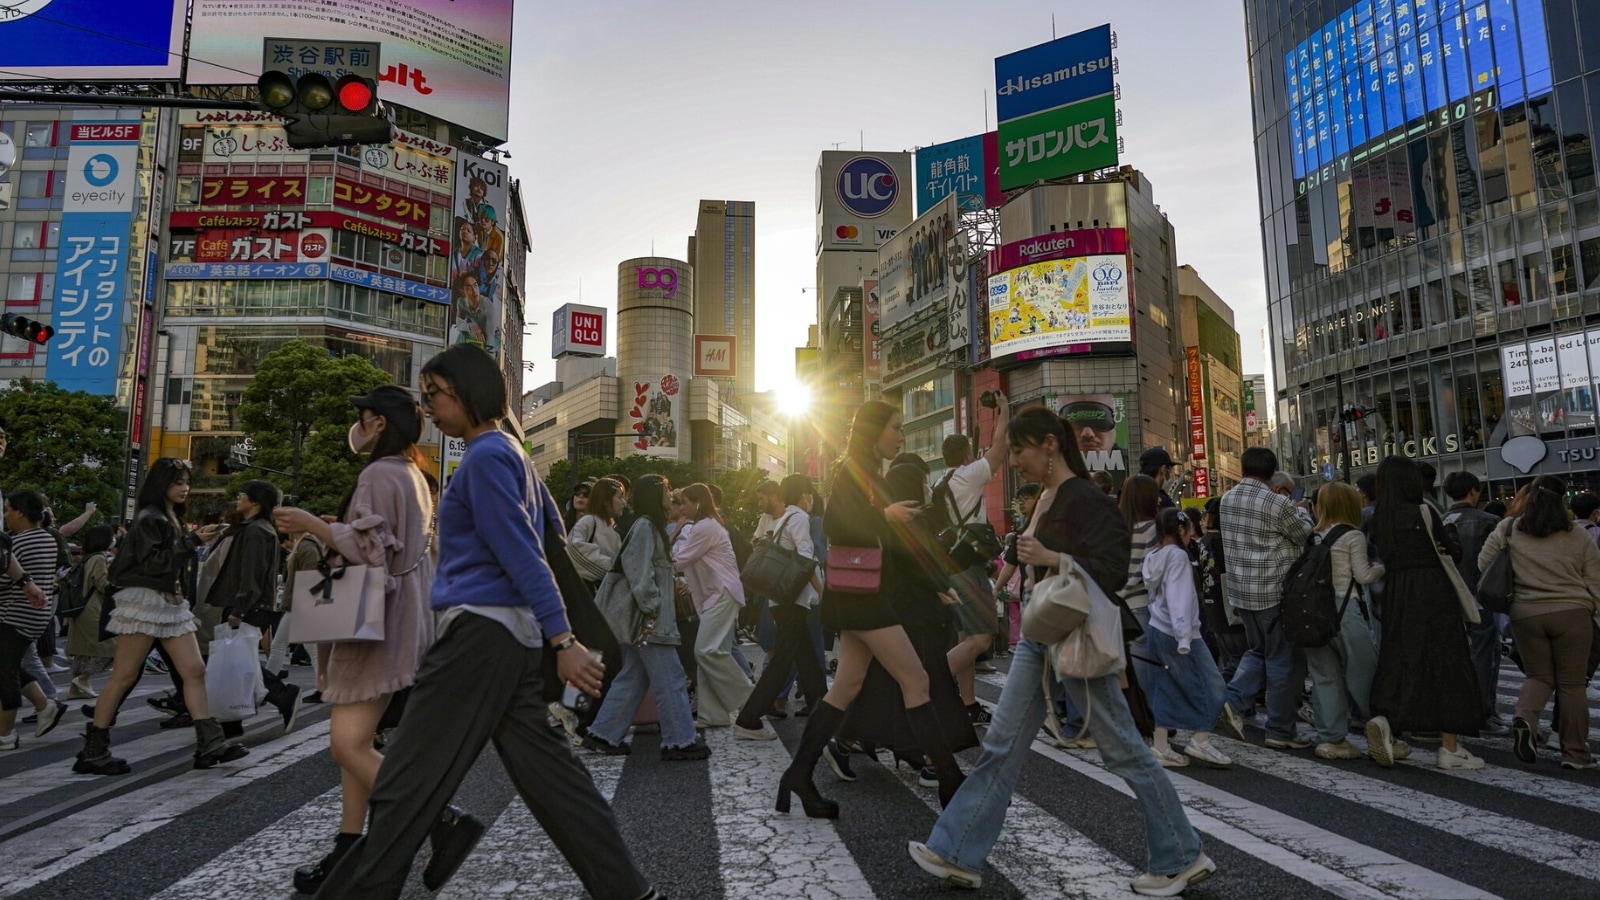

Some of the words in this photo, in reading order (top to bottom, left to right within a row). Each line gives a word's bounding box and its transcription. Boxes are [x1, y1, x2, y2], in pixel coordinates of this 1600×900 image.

[273, 44, 370, 67] 渋谷駅前
[998, 56, 1110, 96] Hisamitsu
[77, 125, 134, 139] 当ビル5F
[241, 133, 298, 153] しゃぶ
[1005, 117, 1109, 168] サロンパス
[182, 138, 203, 151] 9F
[393, 151, 450, 184] しゃぶ葉
[463, 158, 502, 188] Kroi
[930, 153, 970, 180] 龍角散
[72, 189, 126, 205] eyecity
[204, 180, 303, 199] プライス
[925, 173, 978, 199] ダイレクト
[334, 180, 427, 221] コンタクト
[262, 211, 312, 230] ガスト
[171, 240, 196, 255] 7F
[201, 239, 228, 251] Café
[230, 236, 292, 261] ガスト
[304, 244, 325, 252] ガスト
[399, 231, 441, 255] ガスト
[1019, 237, 1075, 257] Rakuten
[170, 264, 200, 276] AEON
[209, 264, 301, 277] 英会話イーオン
[635, 265, 678, 299] 109
[336, 267, 364, 280] AEON
[370, 274, 449, 300] 英会話イーオン
[948, 237, 969, 344] もんじゃ
[57, 235, 96, 367] アイシティ
[88, 235, 121, 367] コンタクトの
[574, 328, 599, 342] QLO
[575, 316, 597, 330] UNI
[1508, 341, 1573, 359] Time-baed
[1510, 360, 1528, 369] 240
[1531, 356, 1554, 366] eats
[1188, 349, 1200, 411] クスリのことなら
[1112, 397, 1126, 424] 再び
[449, 440, 467, 452] 6.19
[1192, 415, 1204, 454] 三千里
[1310, 433, 1460, 474] STARBUCKS
